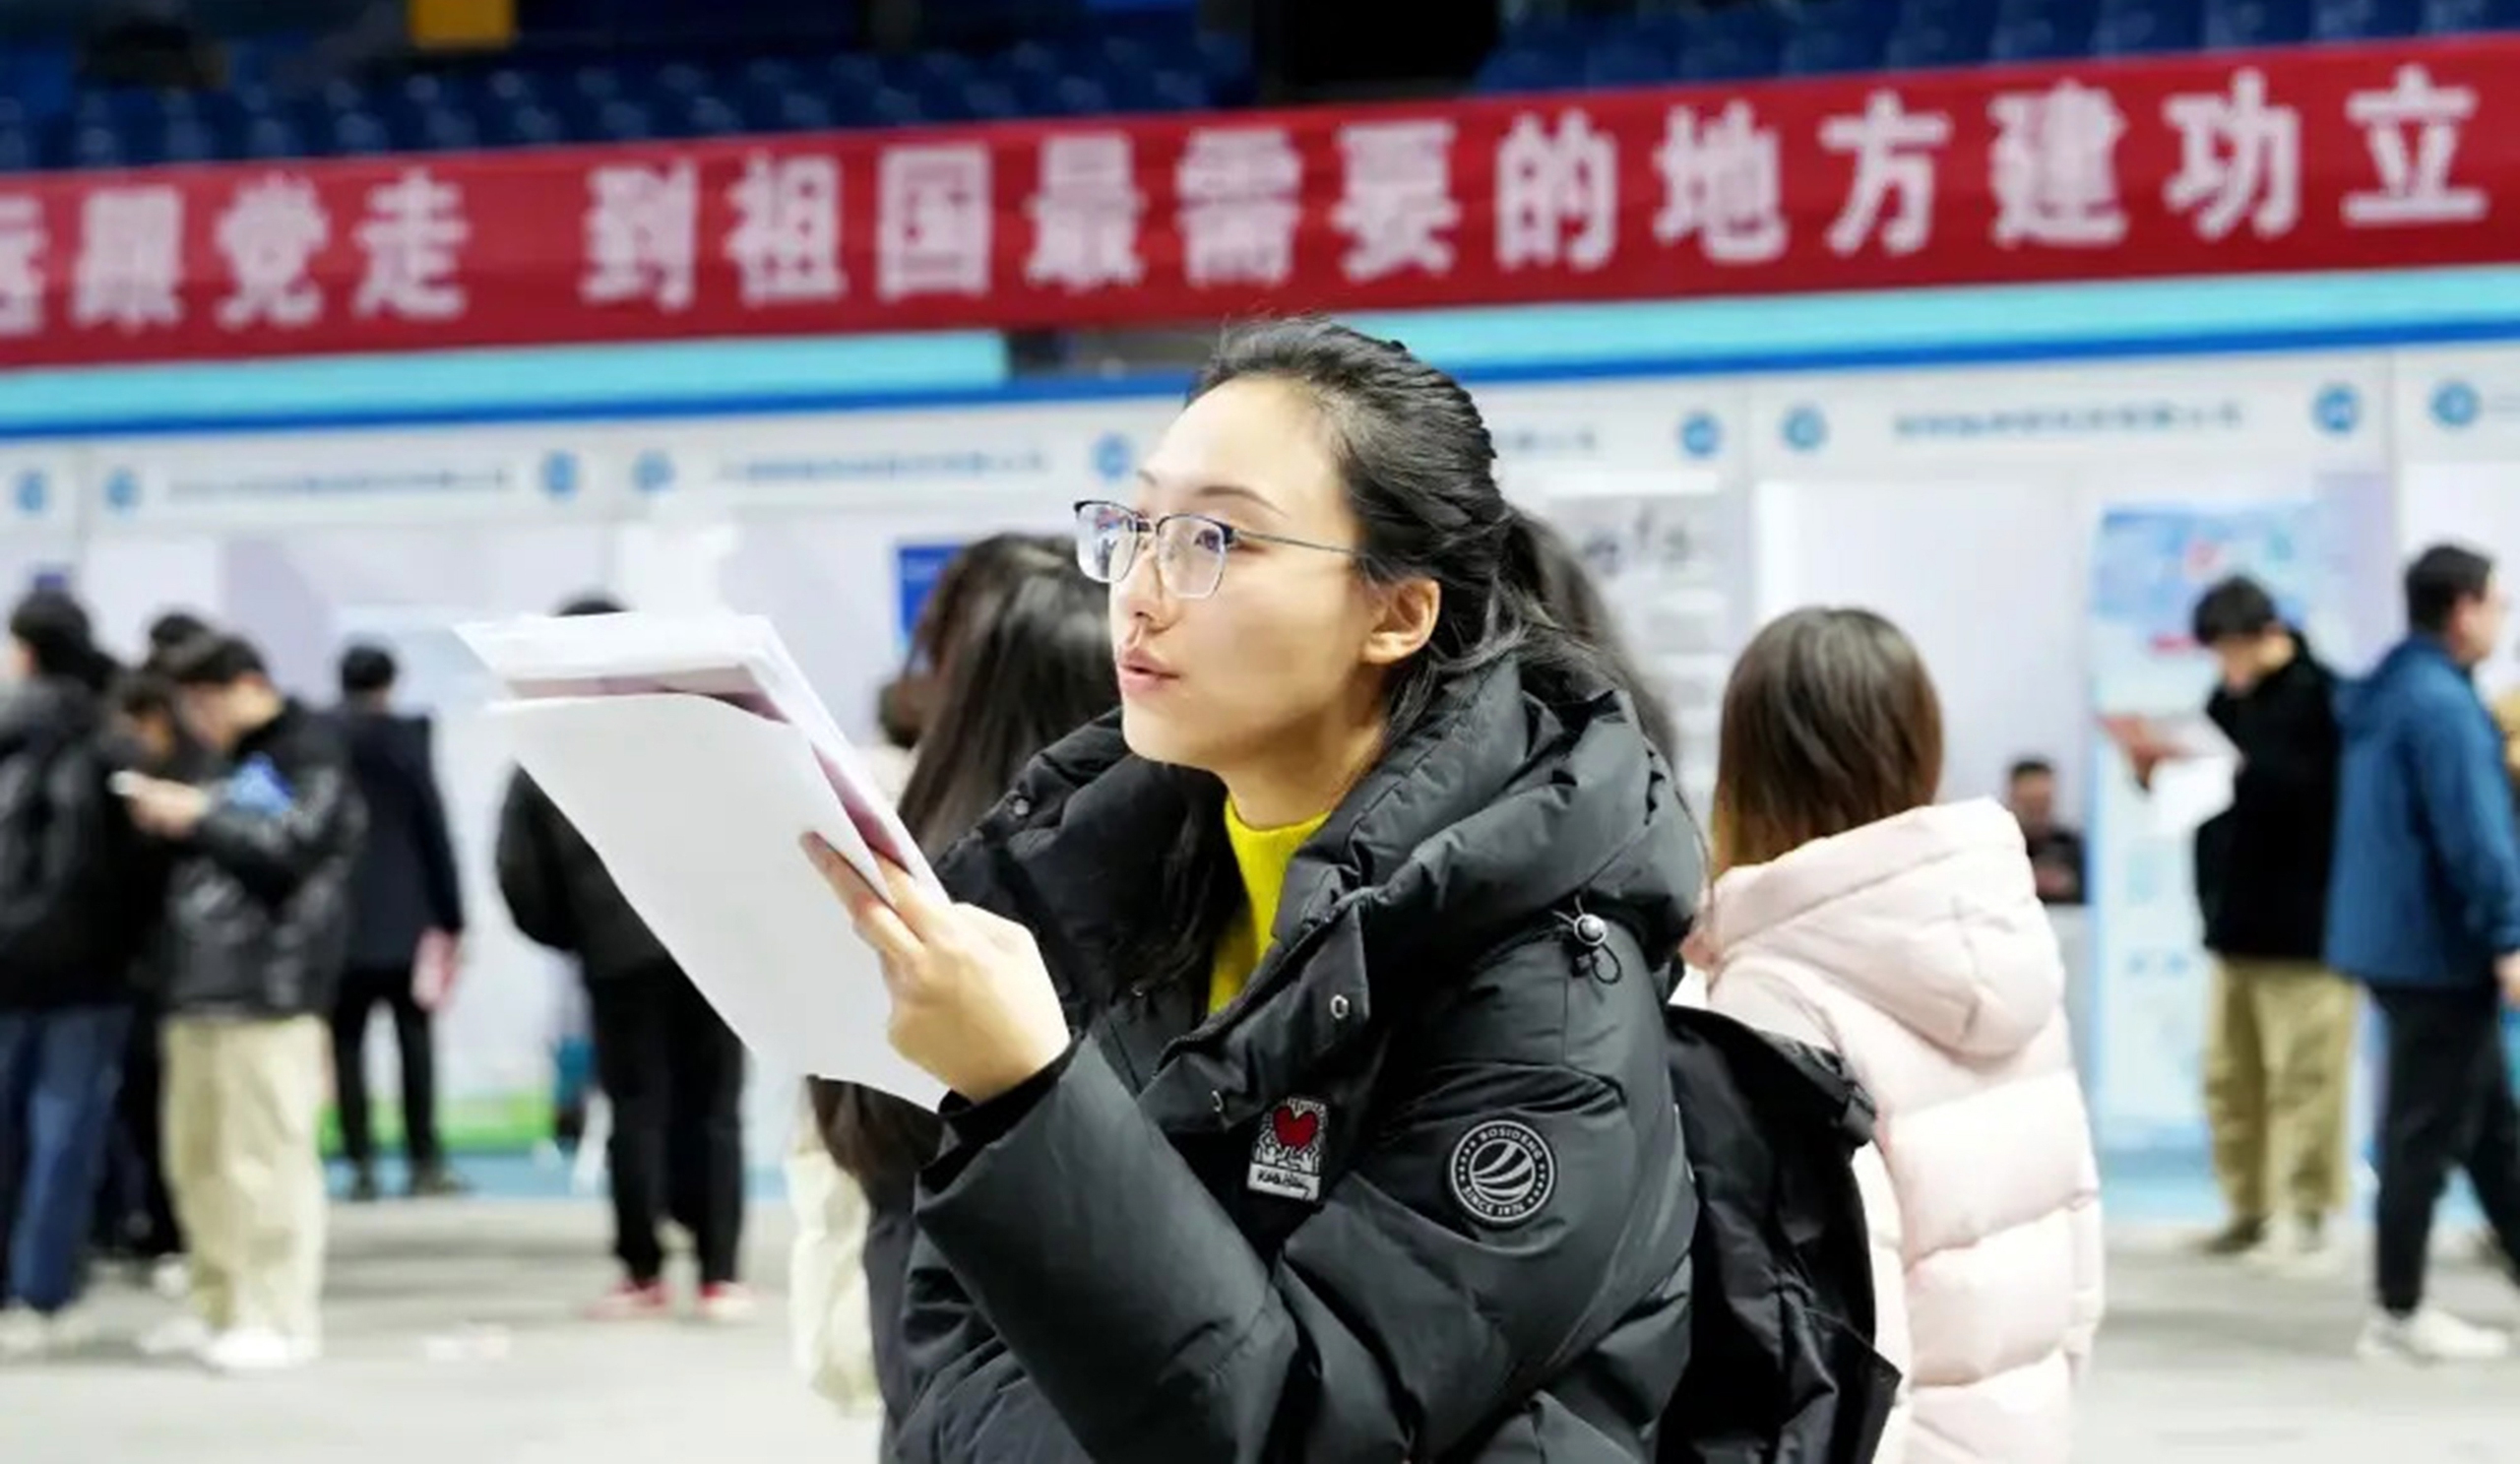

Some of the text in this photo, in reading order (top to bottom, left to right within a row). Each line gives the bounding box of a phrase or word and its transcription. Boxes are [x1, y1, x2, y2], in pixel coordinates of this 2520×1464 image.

[582, 64, 2488, 314] 到祖国最需要的地方建功立
